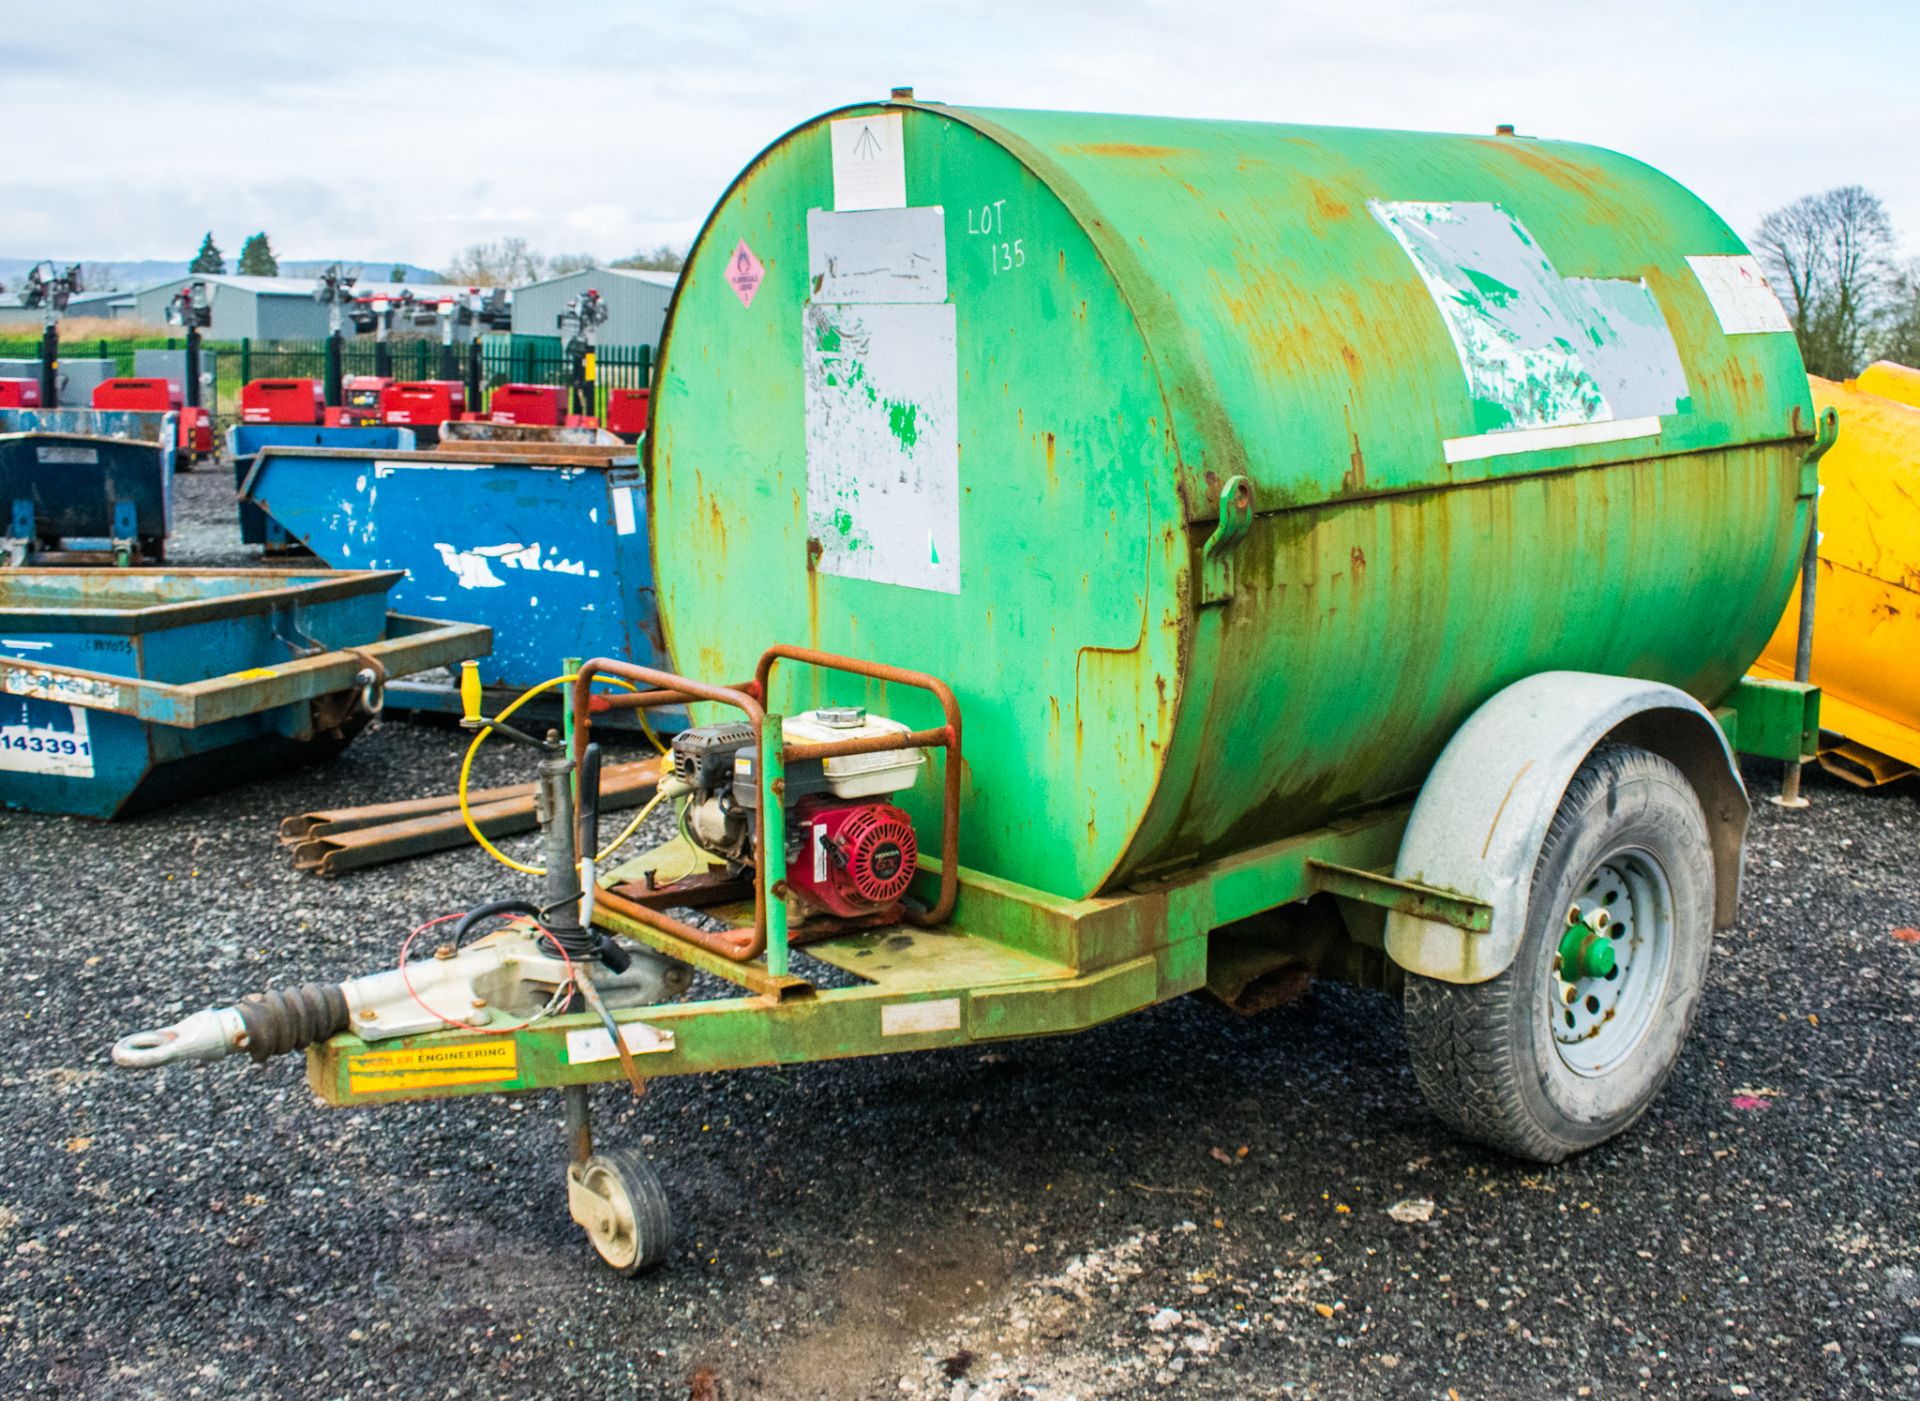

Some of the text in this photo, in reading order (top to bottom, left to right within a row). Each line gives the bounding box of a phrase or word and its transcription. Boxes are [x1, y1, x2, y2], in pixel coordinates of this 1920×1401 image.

[968, 199, 1006, 235] LOT
[992, 238, 1025, 275] 135
[1, 735, 90, 756] 143391
[875, 850, 899, 860] HONDA
[418, 1048, 506, 1064] ENGINEERING
